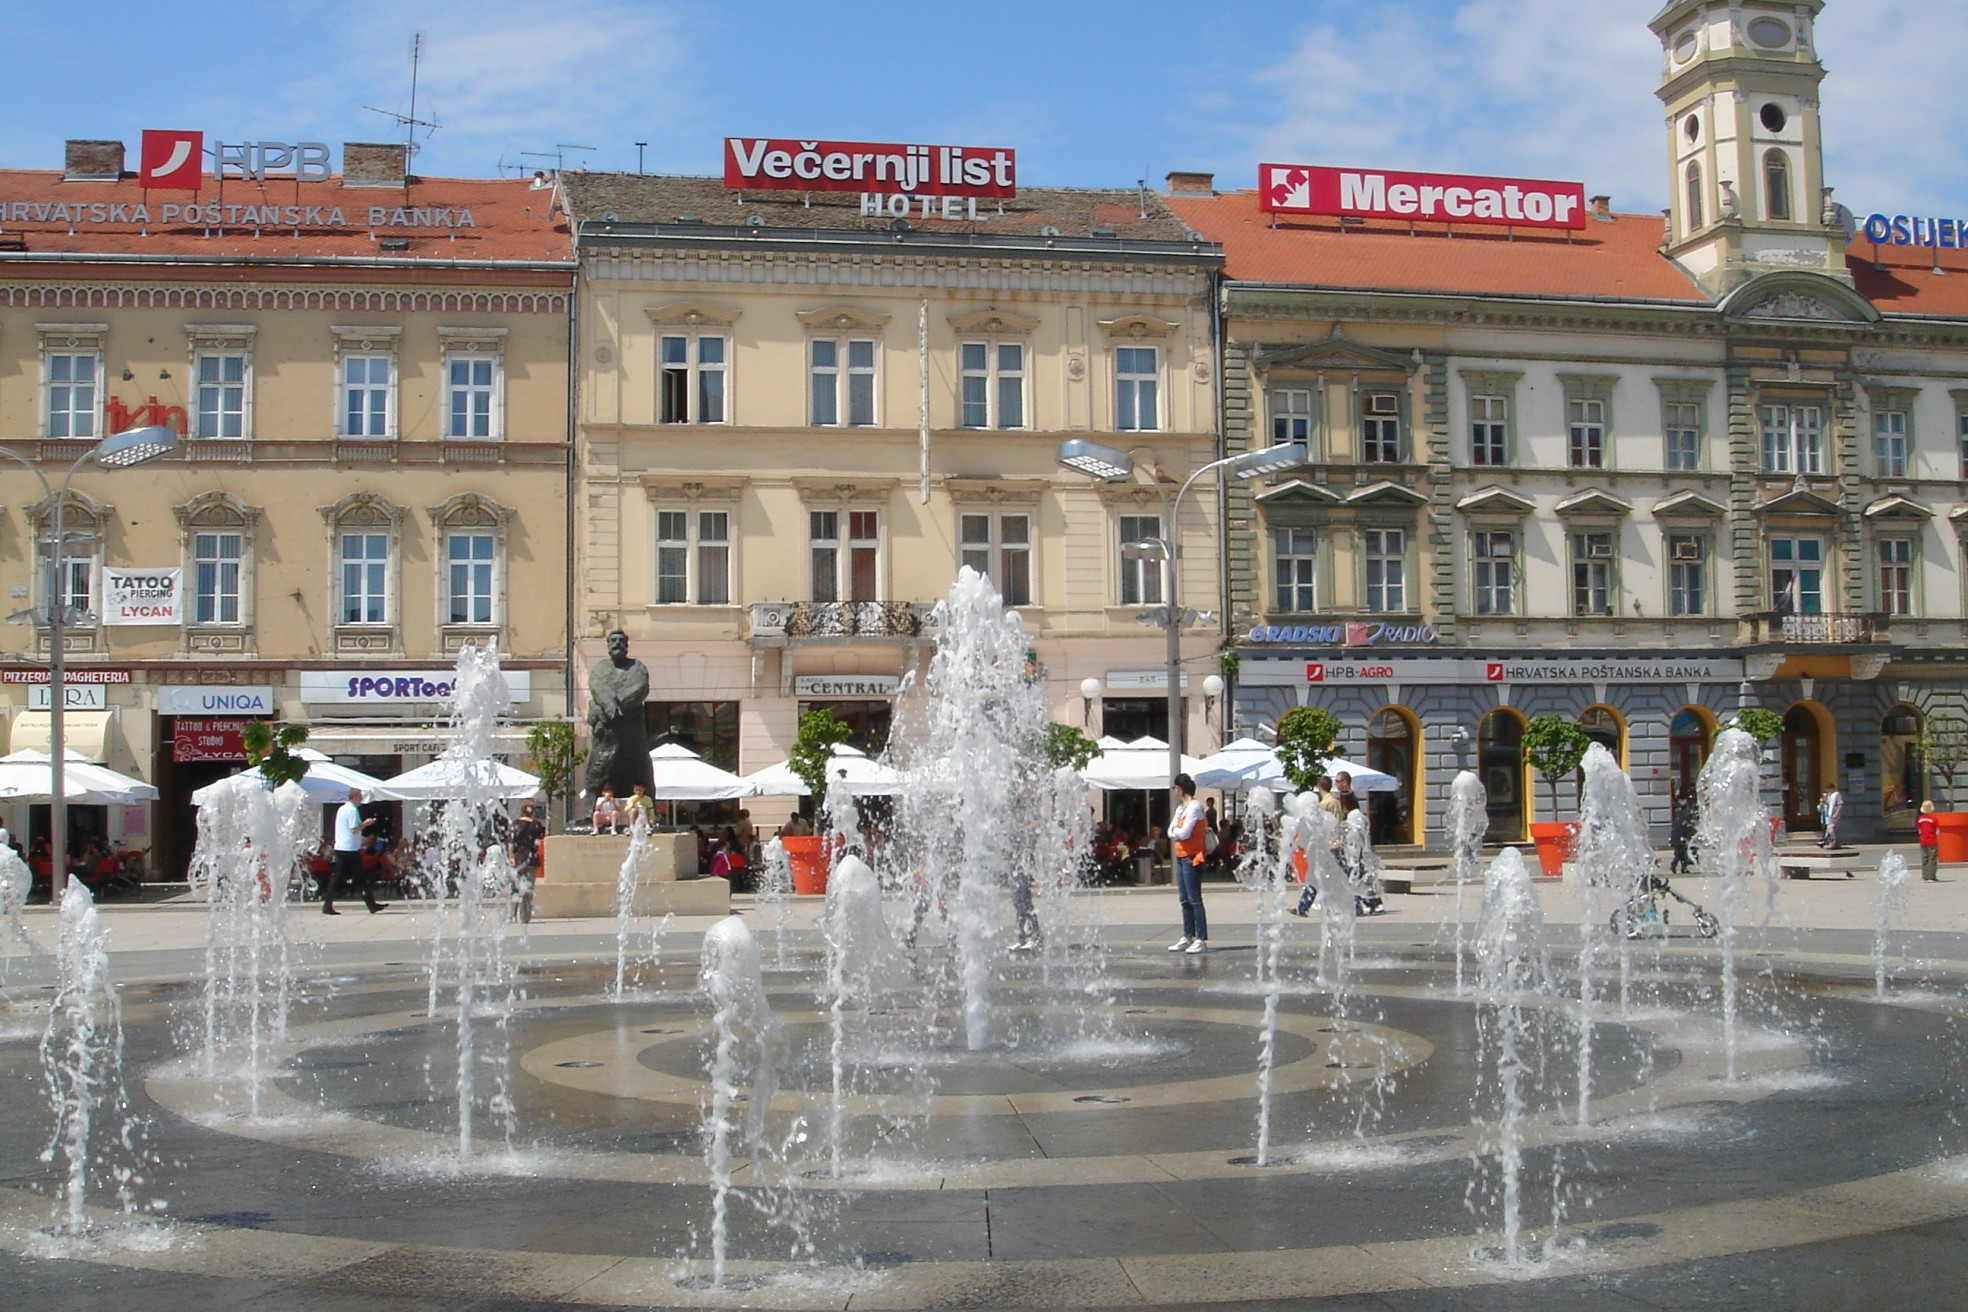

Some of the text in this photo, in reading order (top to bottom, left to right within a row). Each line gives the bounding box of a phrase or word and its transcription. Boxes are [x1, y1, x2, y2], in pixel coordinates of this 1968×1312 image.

[214, 140, 332, 183] HPB
[729, 138, 1012, 191] Večernji list
[1340, 172, 1577, 223] Mercator
[0, 196, 476, 229] HRVATSKA POŠTANSKA BANKA
[860, 191, 988, 222] HOTEL
[110, 576, 173, 589] TATOO
[130, 589, 173, 599] PIERCING
[121, 606, 173, 617] LYCAN
[1249, 624, 1341, 643] GRADSKI
[1383, 624, 1437, 643] RADIO
[3, 671, 129, 683] PIZZERIA PAGHETERIA
[1325, 666, 1394, 679] HPB-AGRO
[1505, 664, 1712, 679] HRVATSKA POŠTANSKA BANKA
[810, 682, 888, 695] CENTRAL
[39, 688, 97, 706] LRA
[202, 694, 264, 710] UNIQA
[176, 721, 202, 732] TATTOO
[198, 735, 224, 747] STUDIO
[393, 743, 420, 752] SPORT
